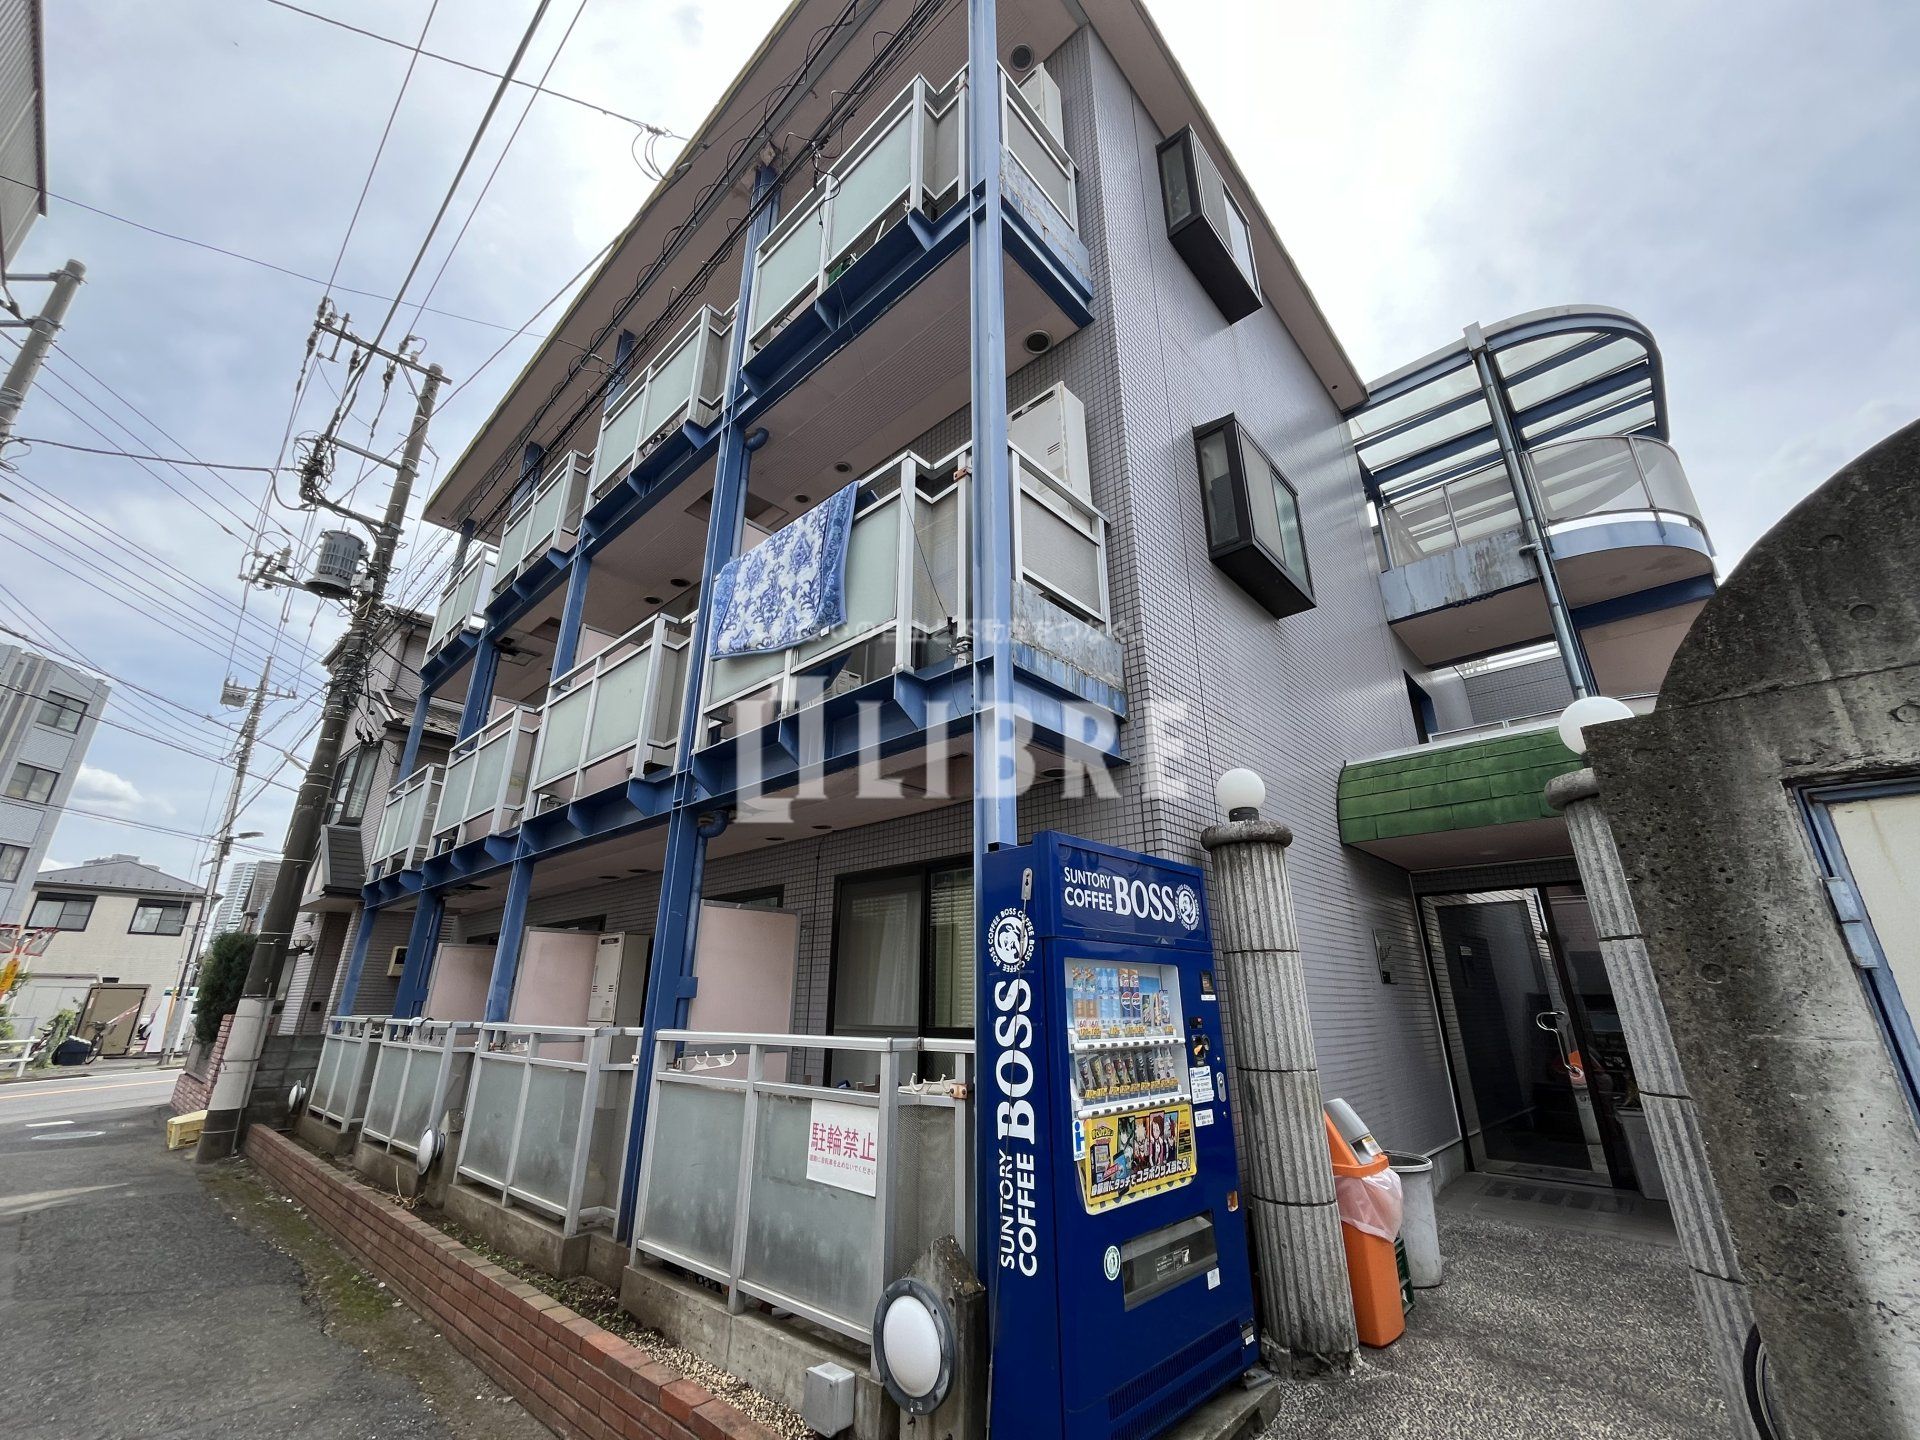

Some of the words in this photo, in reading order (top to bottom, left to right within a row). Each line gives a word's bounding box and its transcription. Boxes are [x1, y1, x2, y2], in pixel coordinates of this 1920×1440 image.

[1064, 866, 1111, 890] SUNTORY
[1000, 907, 1017, 918] BOSS
[1064, 886, 1114, 912] COFFEE
[1112, 875, 1176, 923] BOSS
[987, 915, 1001, 945] COFFEE
[1024, 939, 1036, 962] BOSS
[995, 978, 1036, 1146] BOSS
[811, 1122, 876, 1162] 駐輪禁止
[999, 1148, 1015, 1270] SUNTORY
[1017, 1152, 1038, 1277] COFFEE
